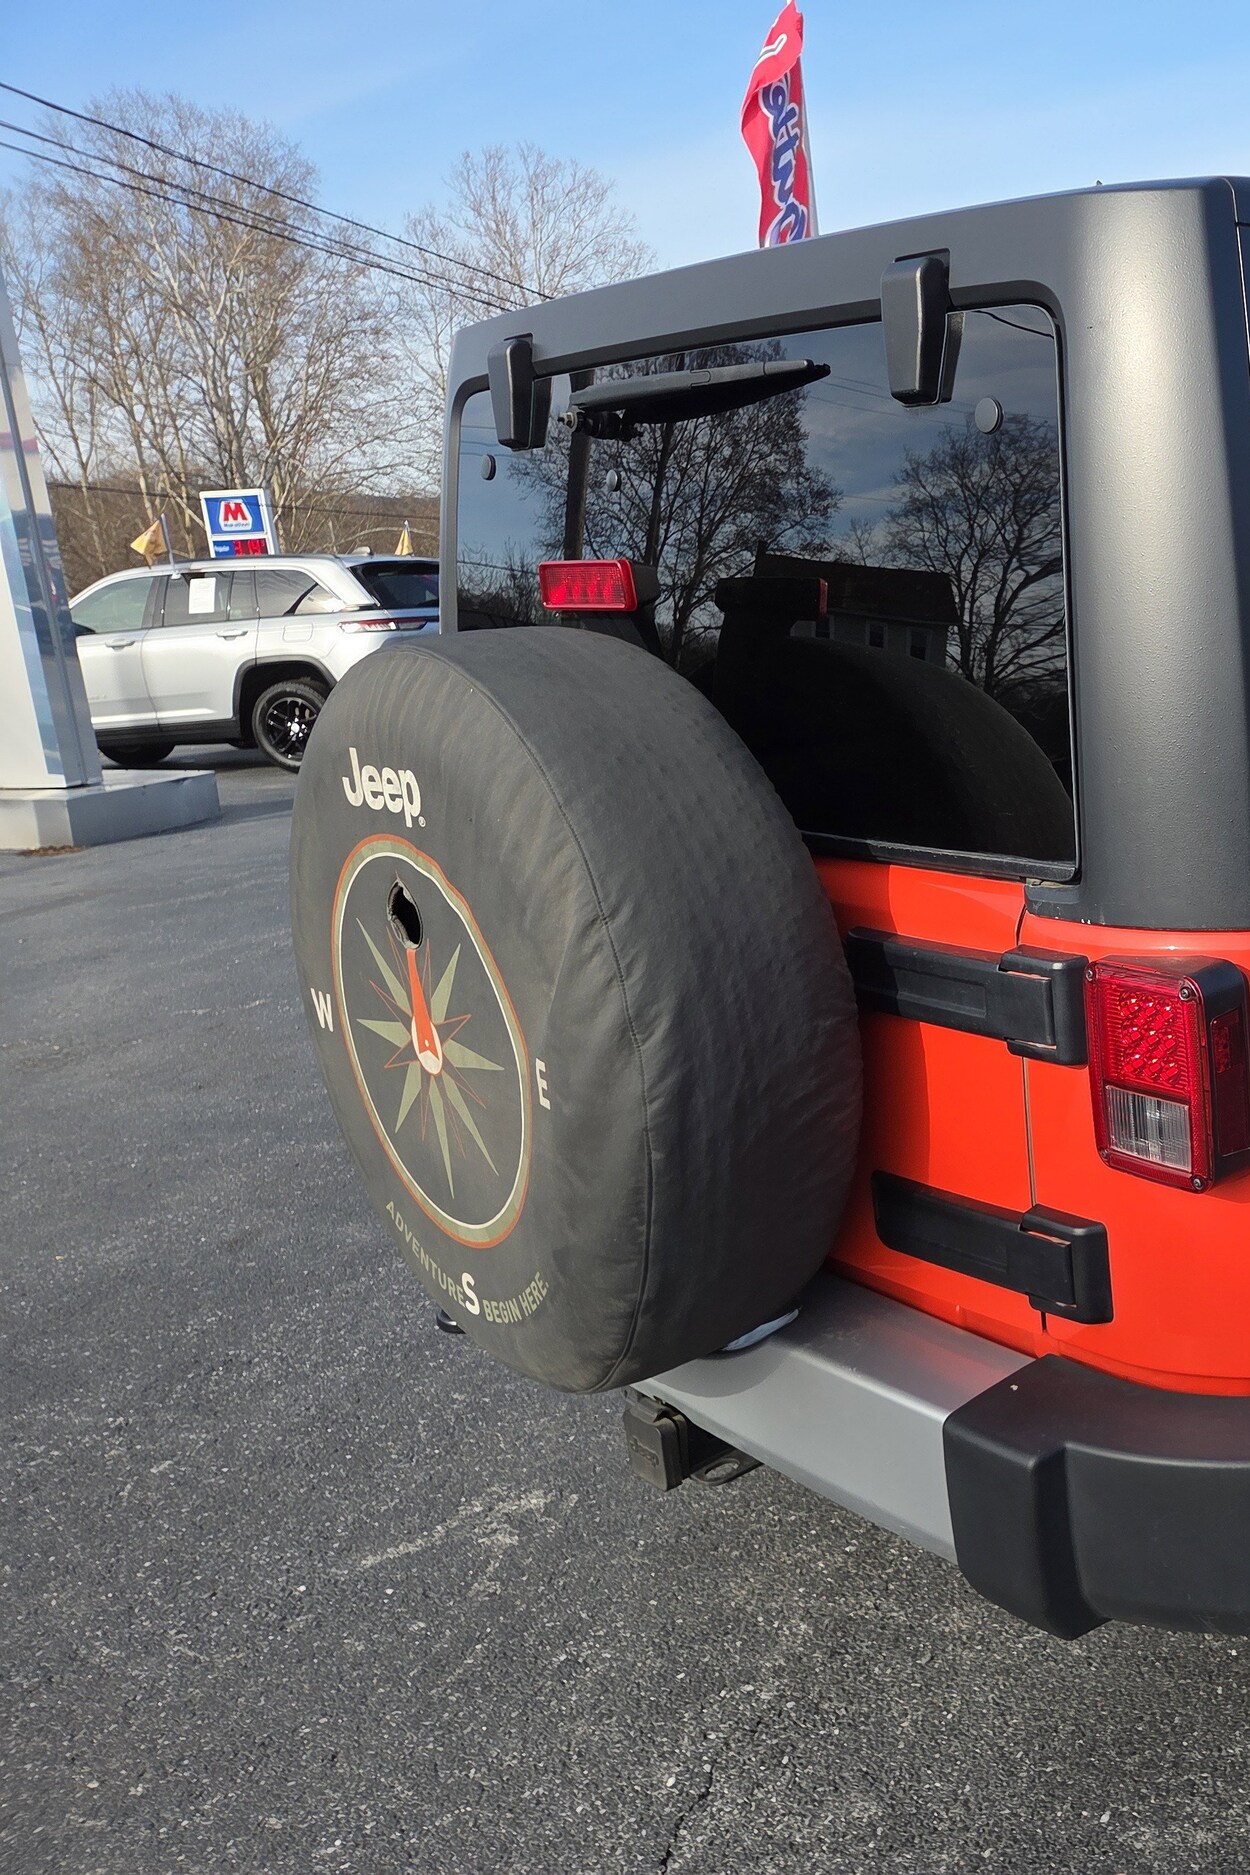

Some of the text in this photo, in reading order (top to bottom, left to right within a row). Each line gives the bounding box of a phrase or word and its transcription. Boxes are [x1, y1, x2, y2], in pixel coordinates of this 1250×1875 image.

[223, 502, 248, 522] M
[341, 746, 422, 828] Jeep
[310, 987, 334, 1033] W
[535, 1057, 551, 1111] E
[482, 1299, 523, 1325] BEGIN
[518, 1271, 550, 1318] HERE.
